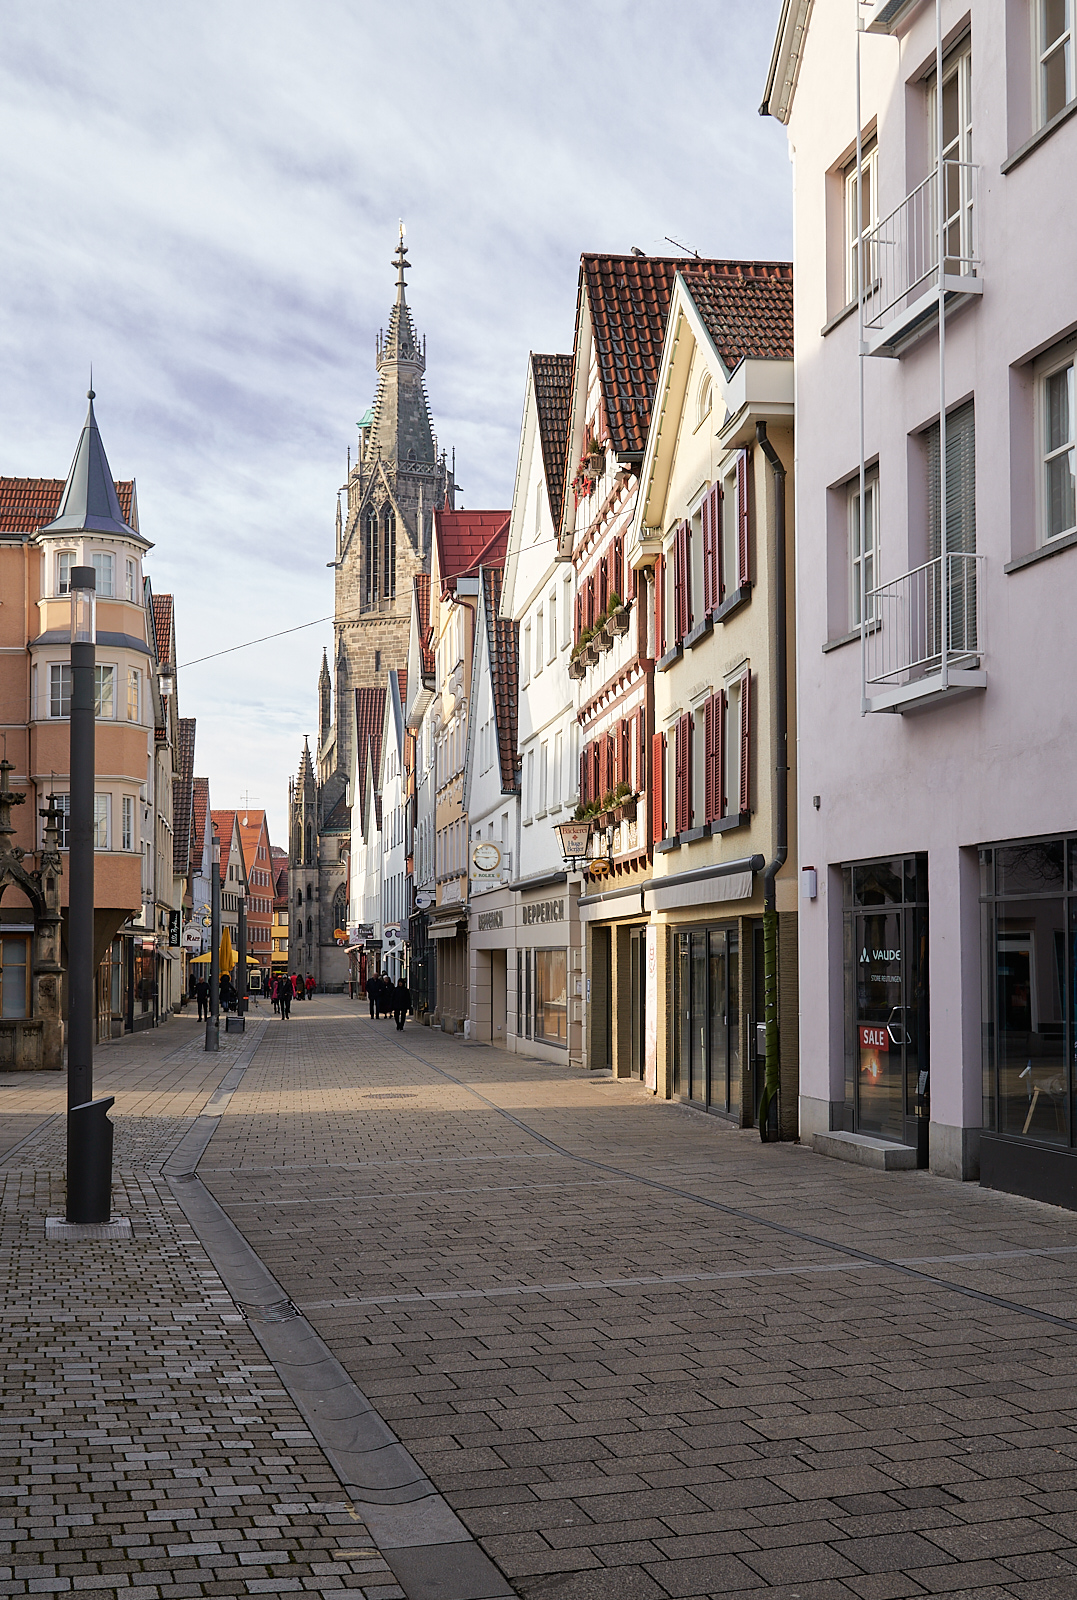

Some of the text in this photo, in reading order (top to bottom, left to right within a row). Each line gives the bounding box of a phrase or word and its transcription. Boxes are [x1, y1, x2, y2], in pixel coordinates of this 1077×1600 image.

[522, 899, 564, 925] DEPPERICH
[872, 949, 901, 961] VAUDE
[863, 1029, 885, 1046] SALE
